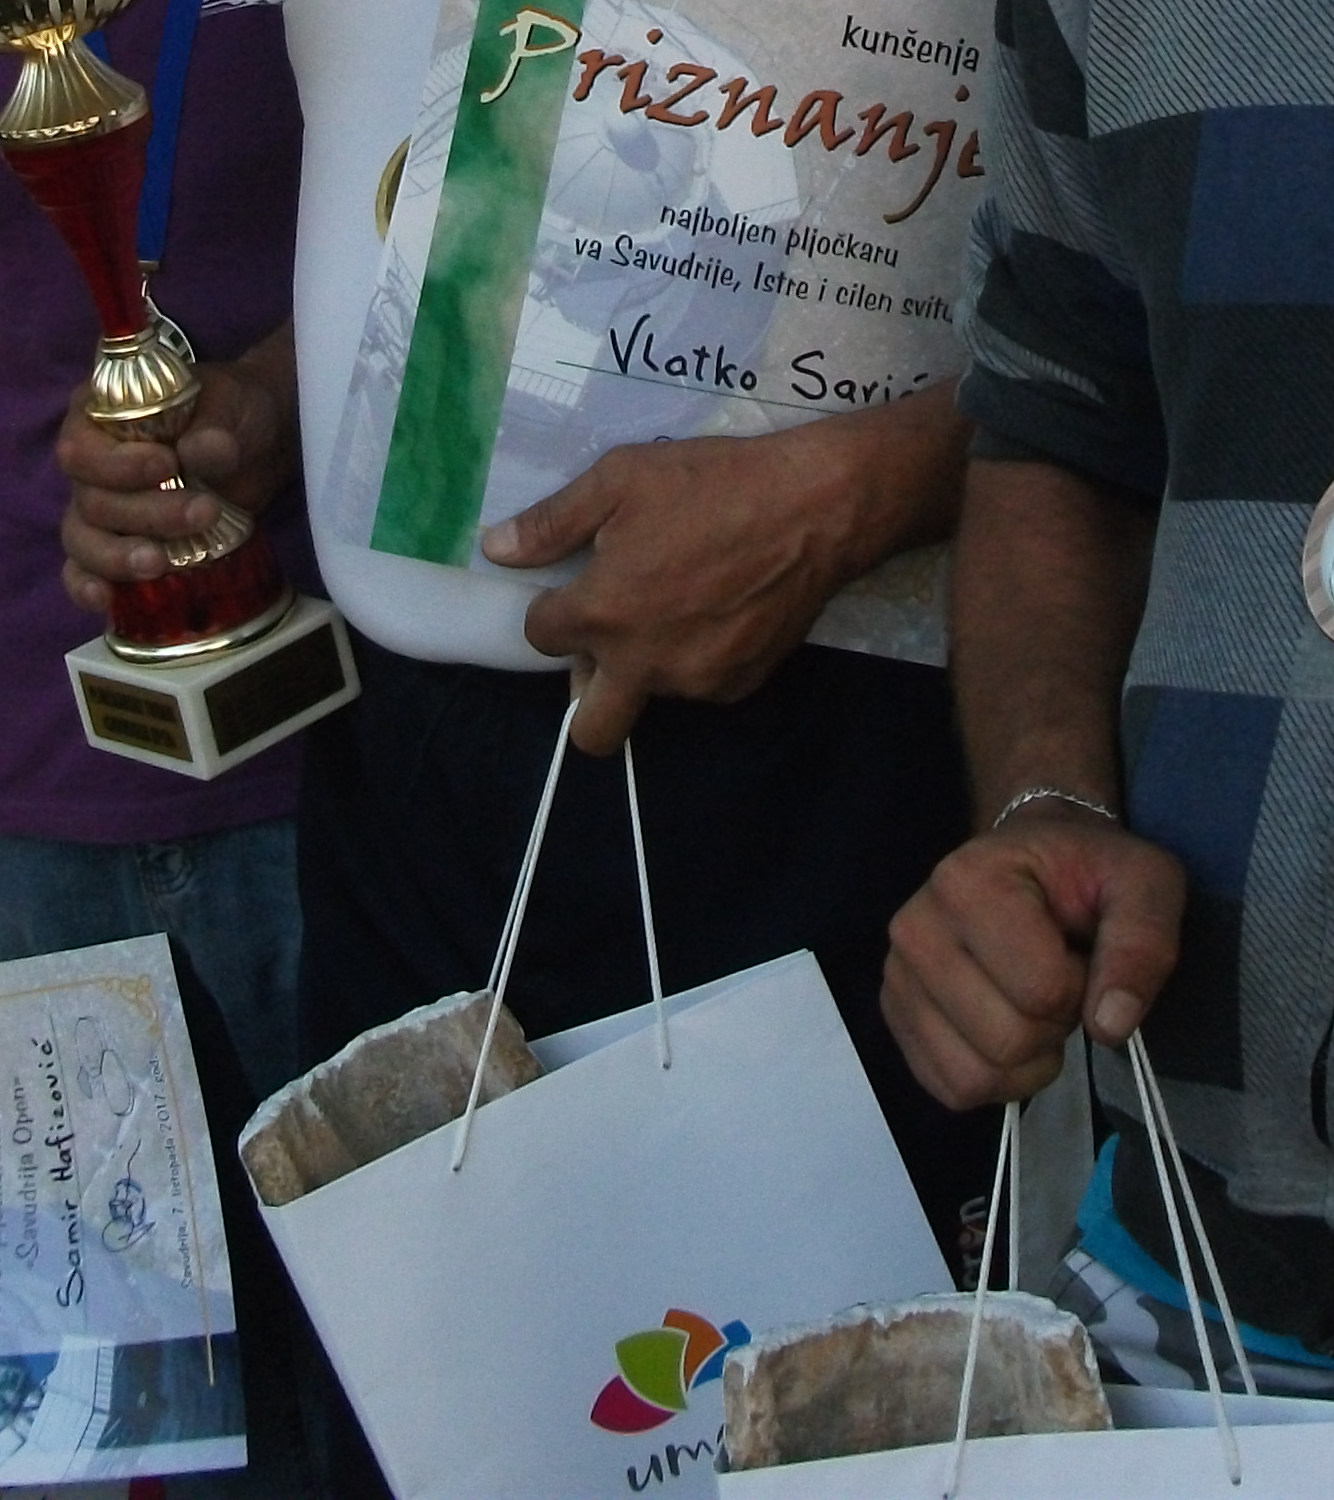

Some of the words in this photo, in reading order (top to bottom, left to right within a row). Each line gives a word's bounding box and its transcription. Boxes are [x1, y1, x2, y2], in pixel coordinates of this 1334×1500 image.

[841, 15, 981, 77] kunšenja
[659, 204, 778, 245] najboljen
[785, 226, 899, 268] pljočkaru
[575, 237, 602, 260] va
[610, 234, 742, 292] Savudrije,
[753, 261, 810, 301] Istre
[817, 278, 828, 302] i
[835, 283, 892, 313] cilen
[791, 350, 929, 404] Sari
[56, 1199, 85, 1308] Samir
[626, 1423, 730, 1492] um
